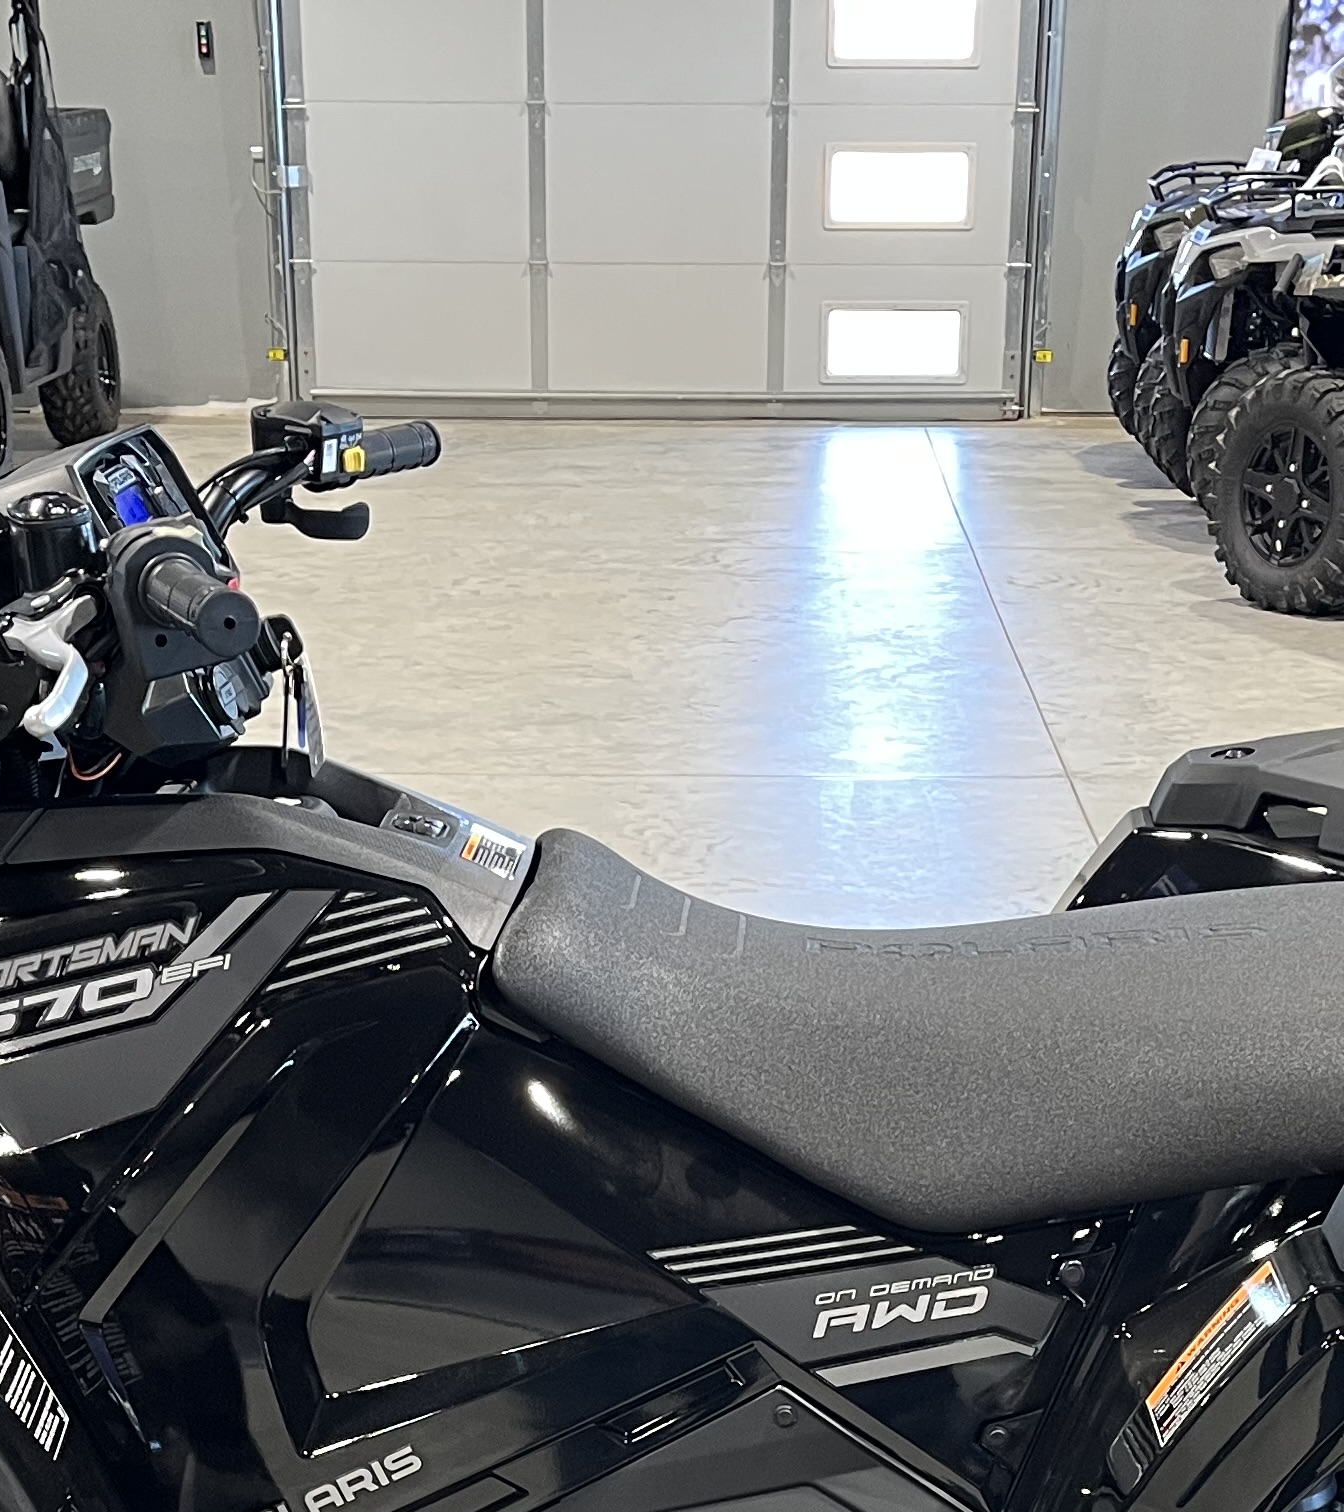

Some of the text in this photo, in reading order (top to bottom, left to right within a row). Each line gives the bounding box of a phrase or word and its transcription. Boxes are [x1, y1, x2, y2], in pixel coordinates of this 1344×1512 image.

[159, 953, 231, 985] EFI
[815, 1267, 995, 1305] ON DEMAND
[812, 1285, 989, 1339] AWD
[1186, 1298, 1241, 1358] WARNING
